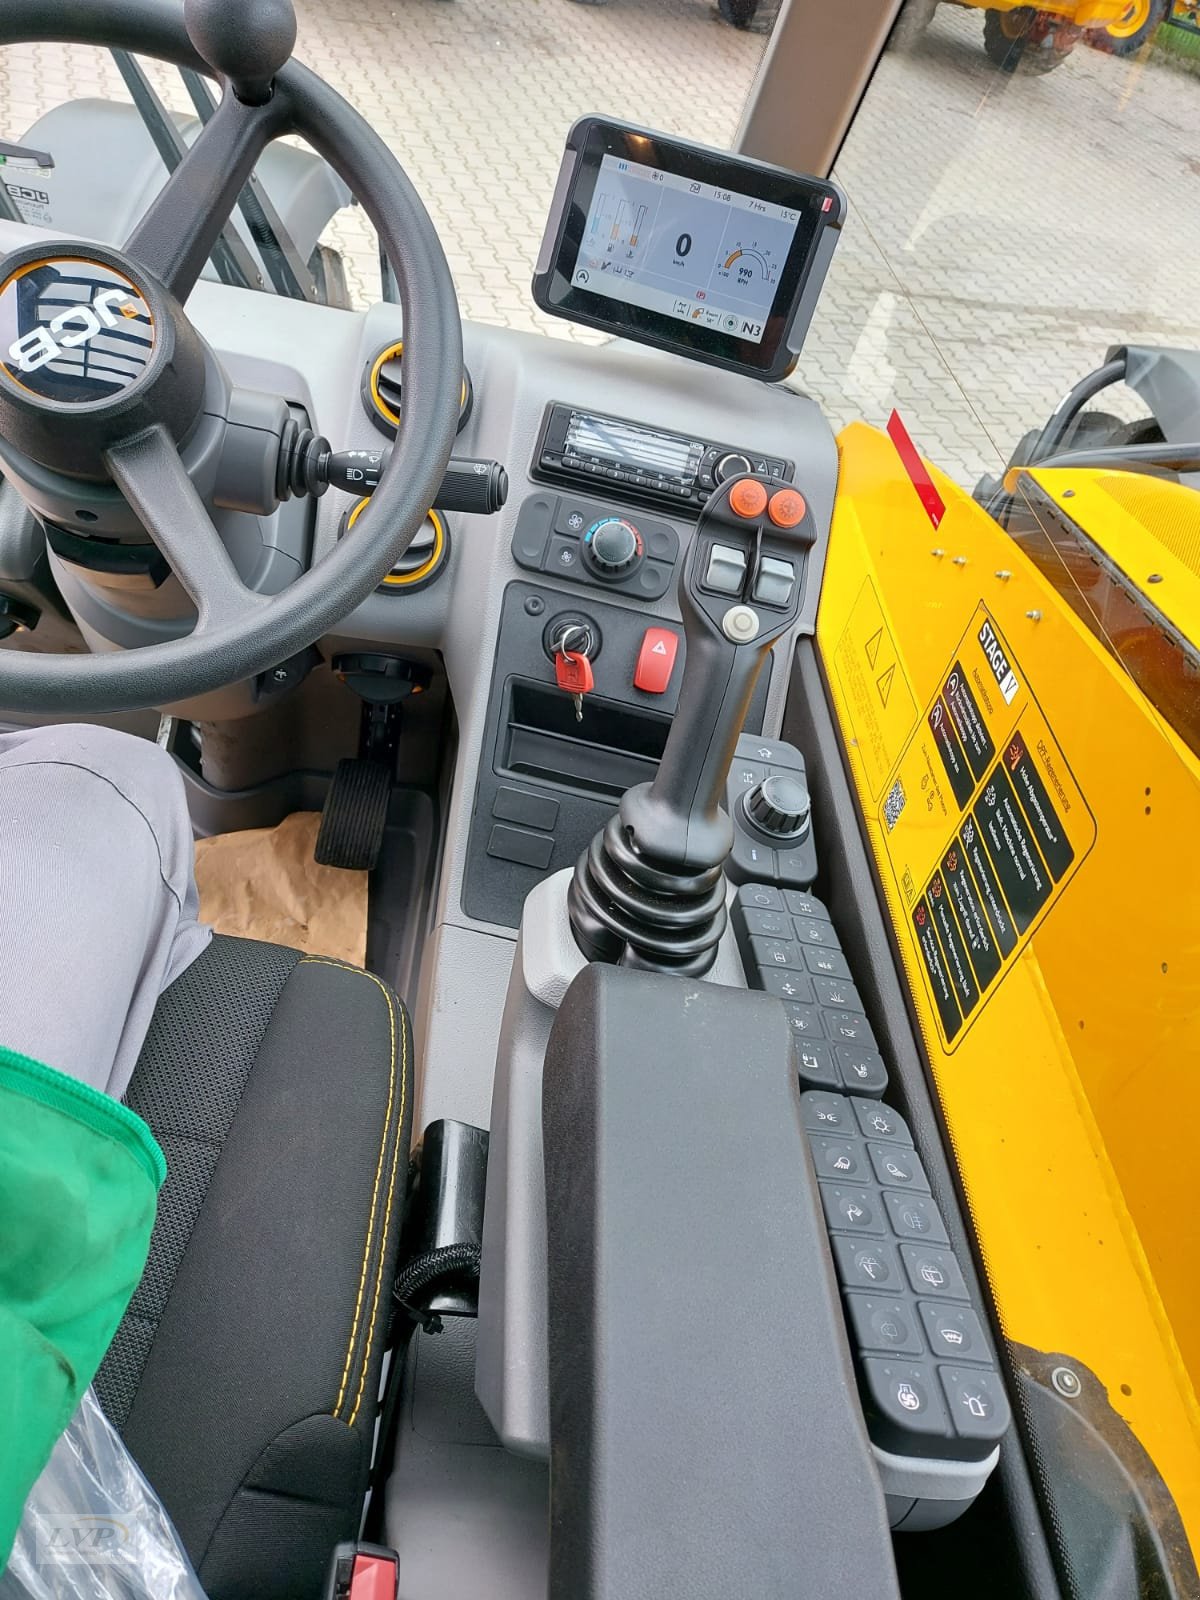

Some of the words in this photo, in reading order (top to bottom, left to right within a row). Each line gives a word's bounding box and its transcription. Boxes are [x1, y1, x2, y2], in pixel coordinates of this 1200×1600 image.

[754, 203, 766, 212] Hrs
[676, 233, 692, 257] 0
[739, 268, 753, 278] 990
[8, 288, 129, 373] JCB
[742, 321, 761, 337] N3
[979, 621, 1007, 680] STAGE
[1004, 676, 1016, 699] V
[1019, 765, 1030, 788] Hohe
